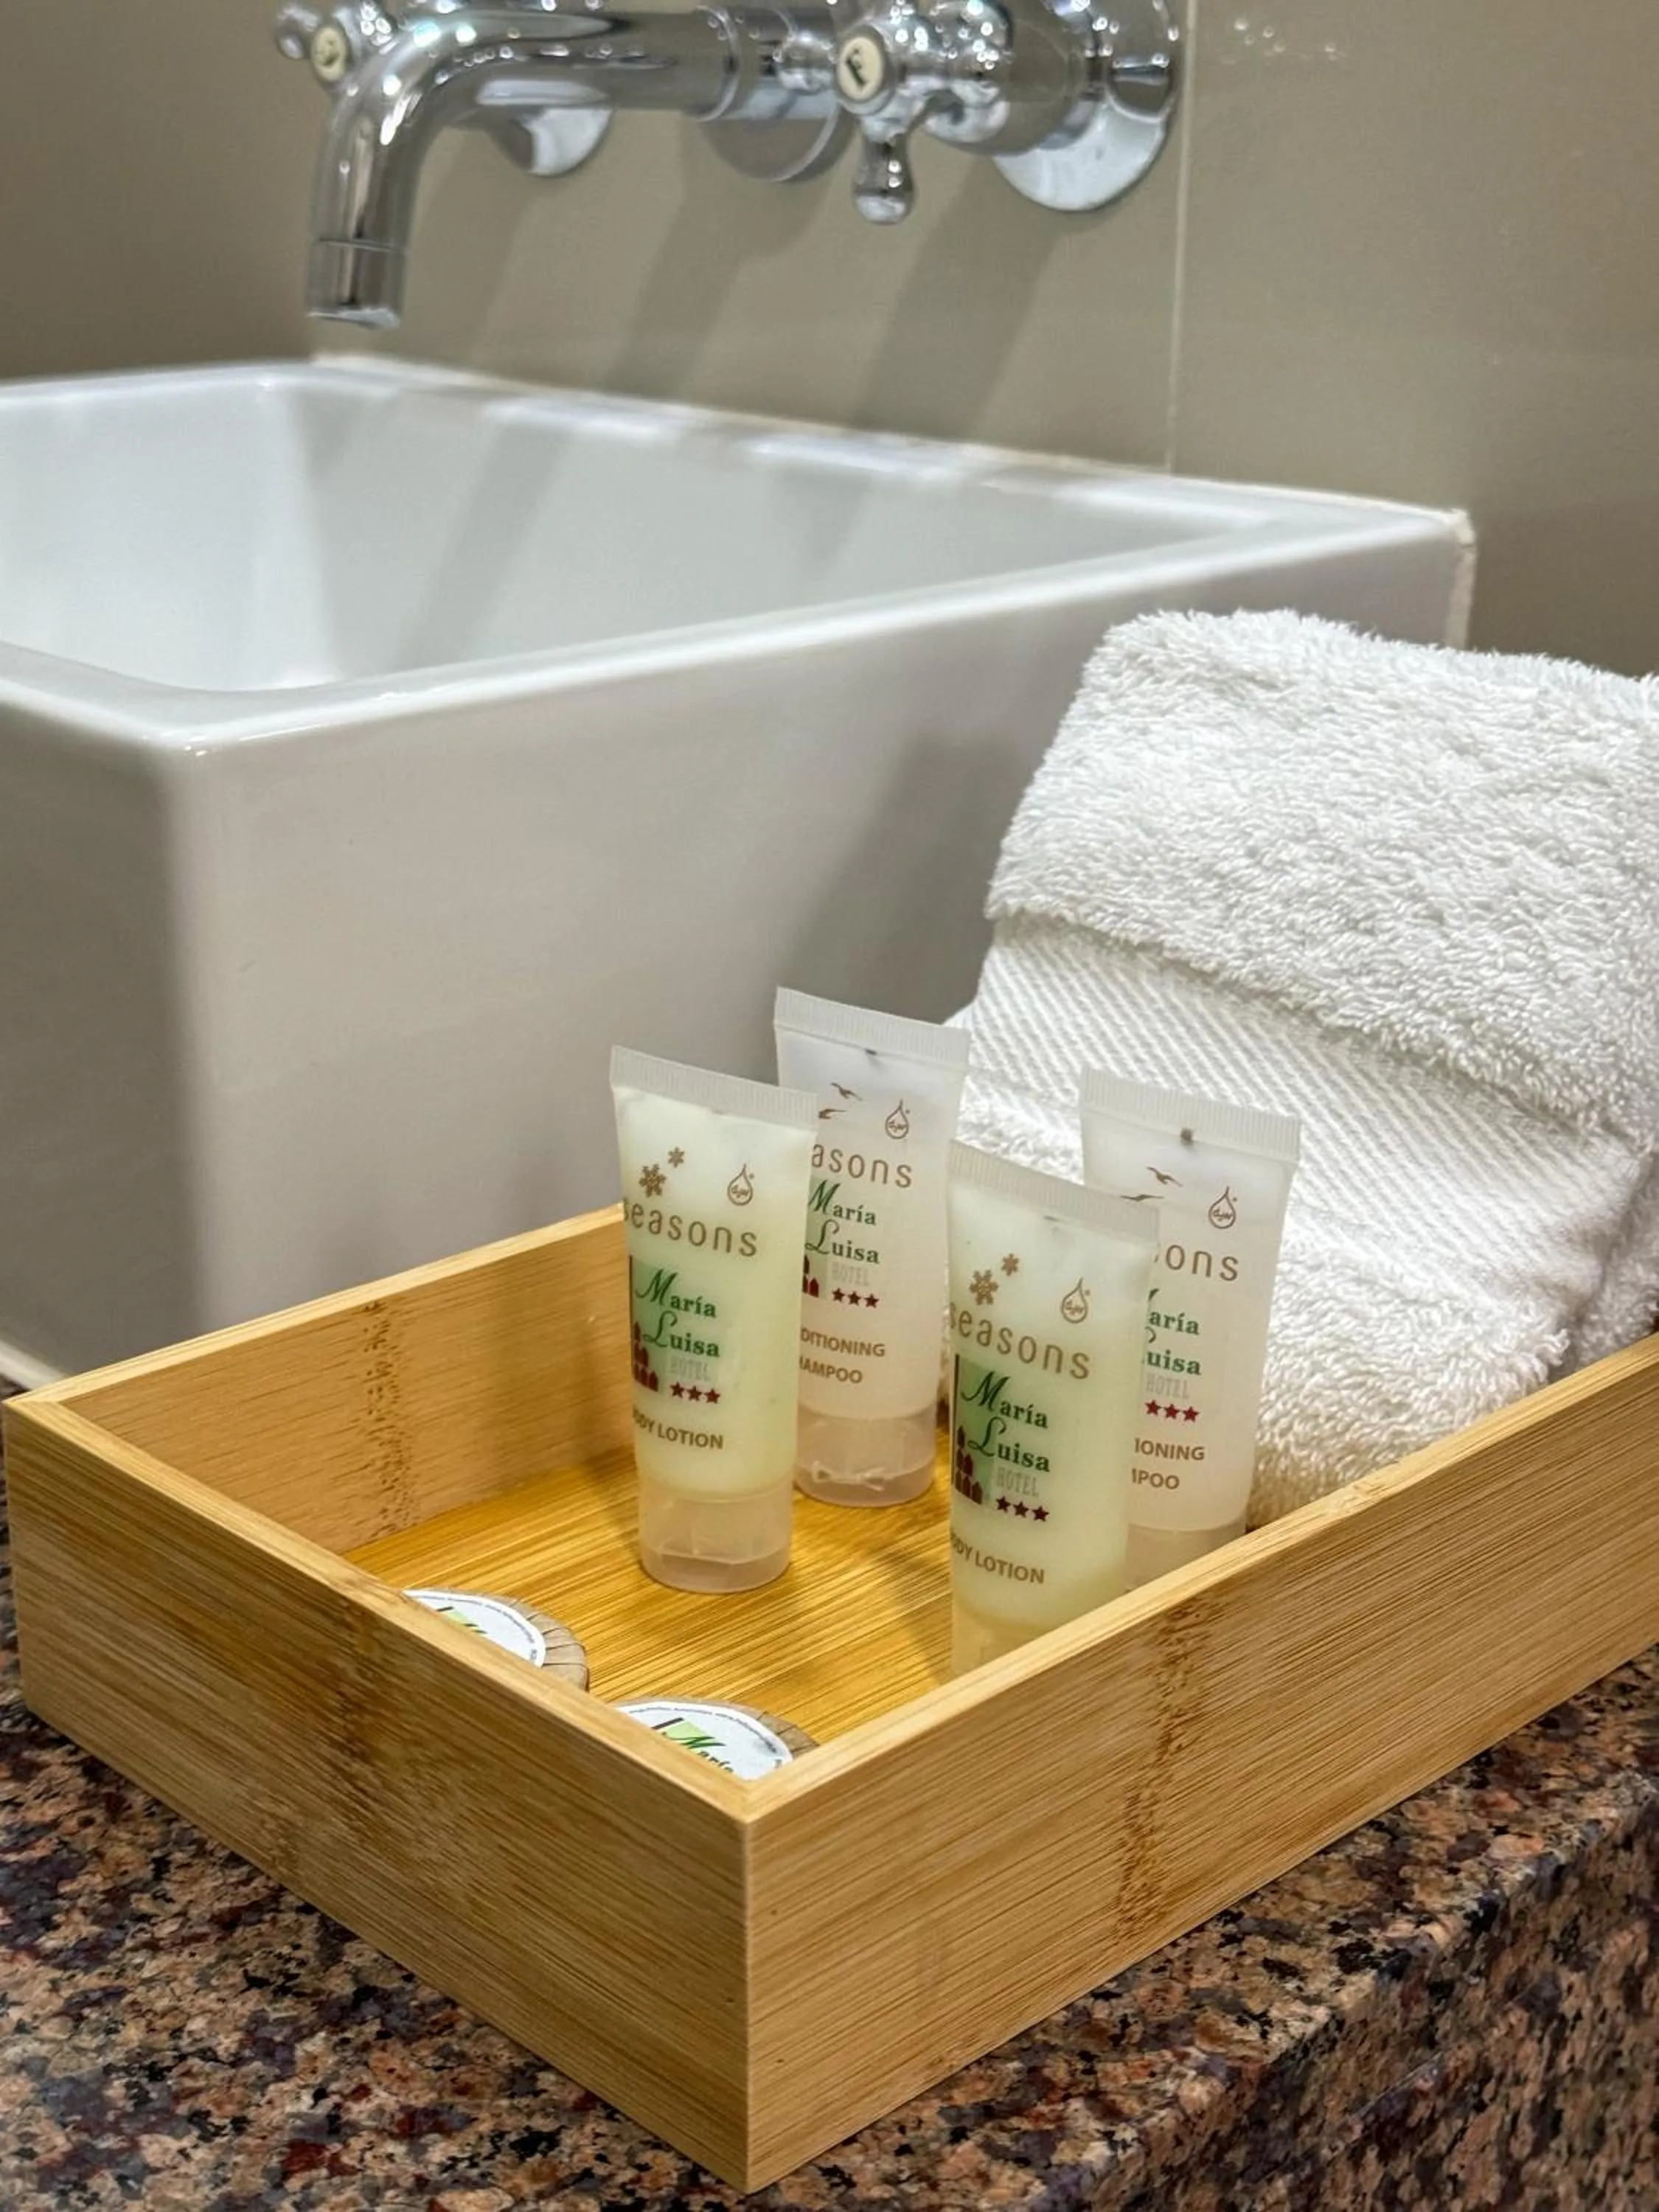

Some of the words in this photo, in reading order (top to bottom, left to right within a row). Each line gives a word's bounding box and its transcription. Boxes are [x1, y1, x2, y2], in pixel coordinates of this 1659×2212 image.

[811, 1144, 913, 1189] asons
[808, 1179, 877, 1225] María
[804, 1218, 880, 1265] Luisa
[635, 1268, 717, 1318] María
[831, 1261, 870, 1287] HOTEL
[642, 1310, 720, 1357] Luisa
[1147, 1287, 1200, 1335] aría
[800, 1326, 886, 1357] DITIONING
[1144, 1326, 1202, 1376] uisa
[799, 1355, 863, 1384] AMPOO
[1145, 1373, 1190, 1399] HOTEL
[960, 1370, 1048, 1429] María
[658, 1423, 724, 1450] LOTION
[967, 1416, 1051, 1472] Luisa
[1134, 1437, 1206, 1461] IONING
[996, 1466, 1040, 1498] HOTEL
[975, 1551, 1045, 1584] LOTION
